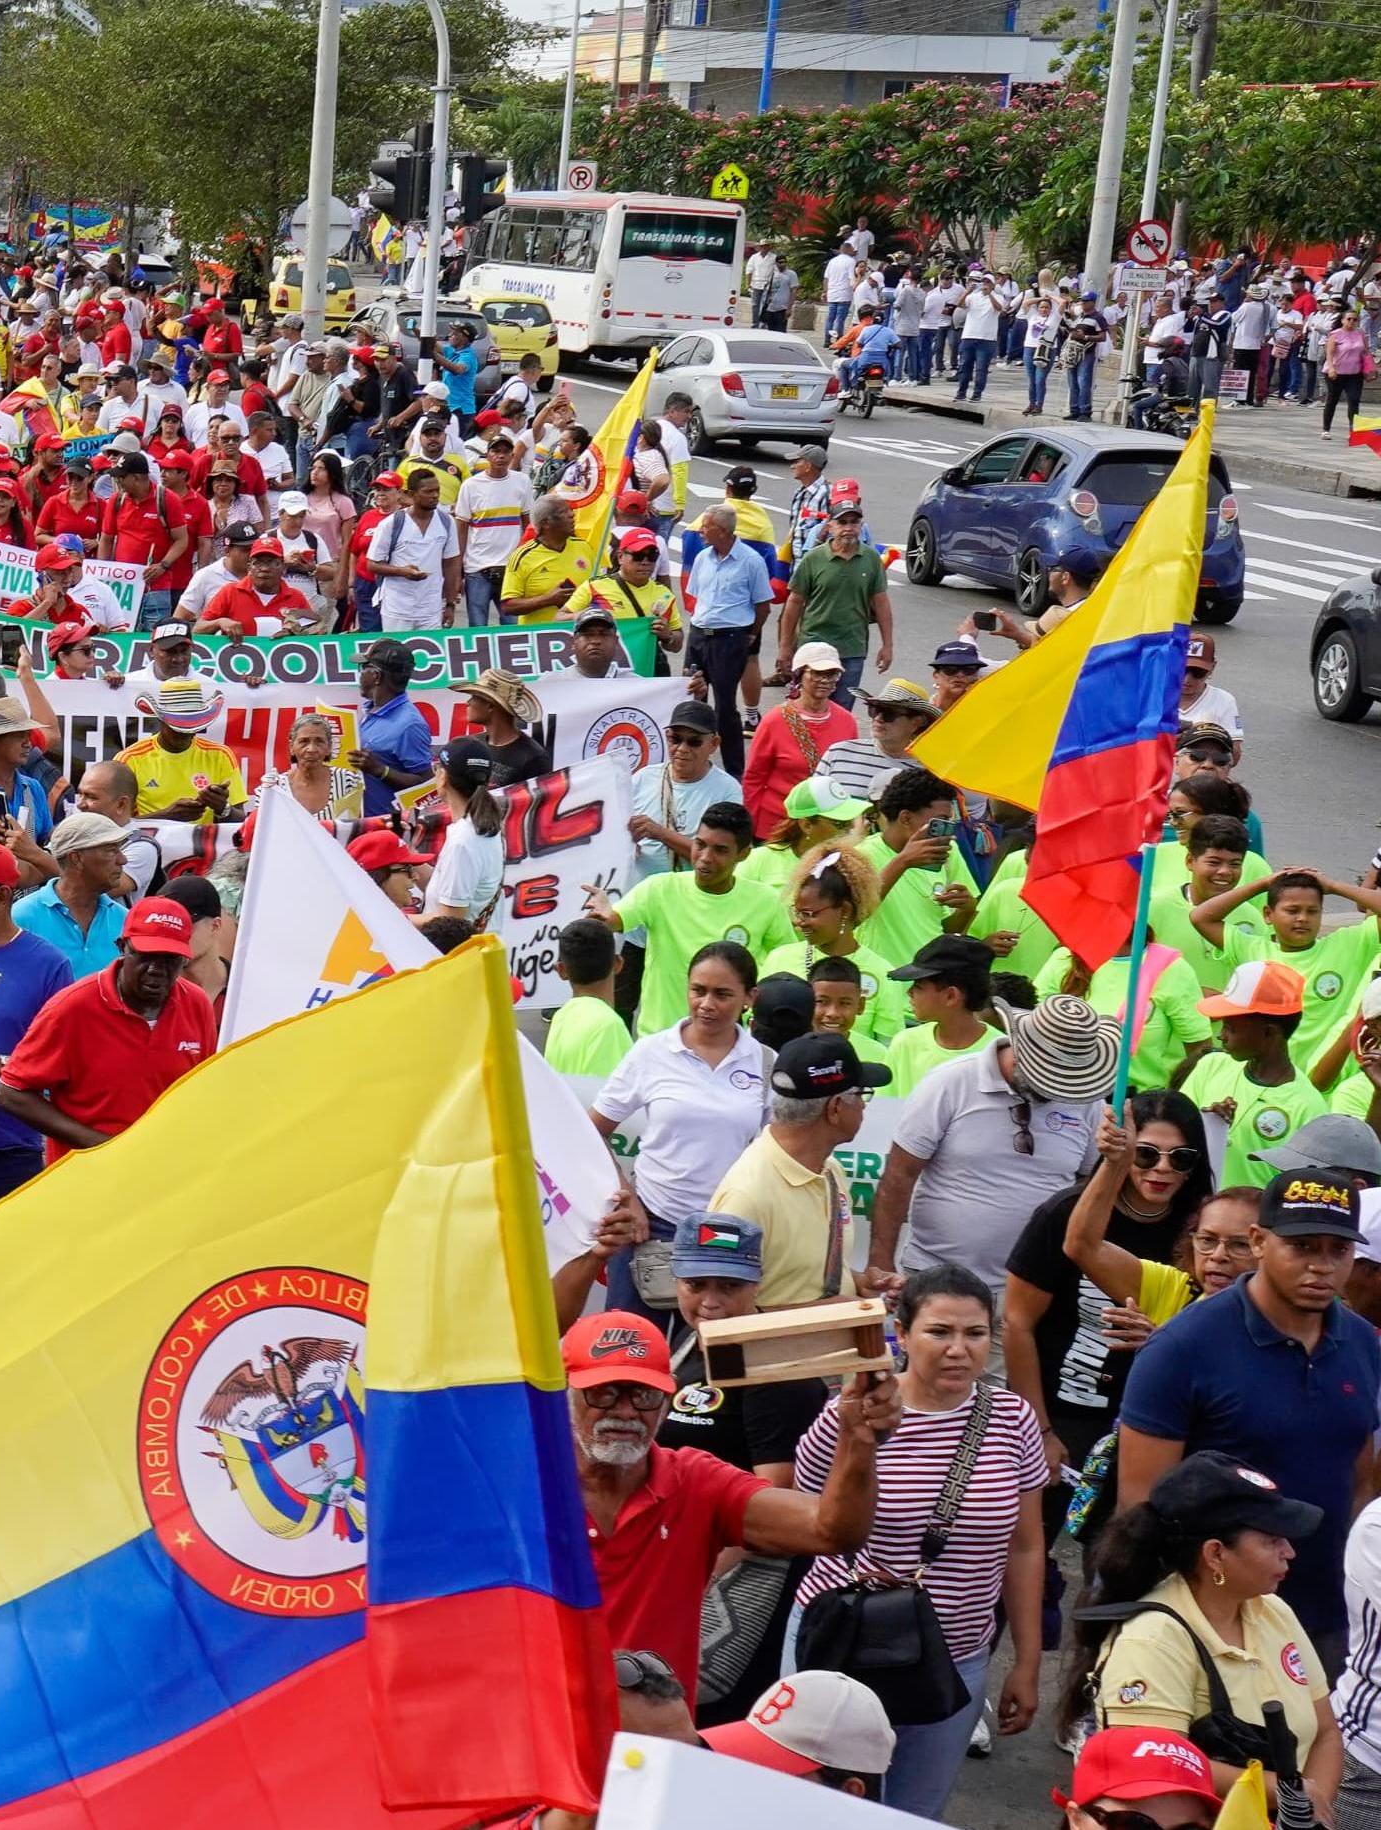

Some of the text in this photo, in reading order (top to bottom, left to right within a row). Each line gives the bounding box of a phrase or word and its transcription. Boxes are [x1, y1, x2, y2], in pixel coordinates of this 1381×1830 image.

[6, 551, 37, 569] DEL
[85, 564, 137, 581] NTICO
[588, 709, 659, 751] SINALTRALAC
[601, 1328, 640, 1344] NIKE
[667, 1411, 715, 1426] Atlántico
